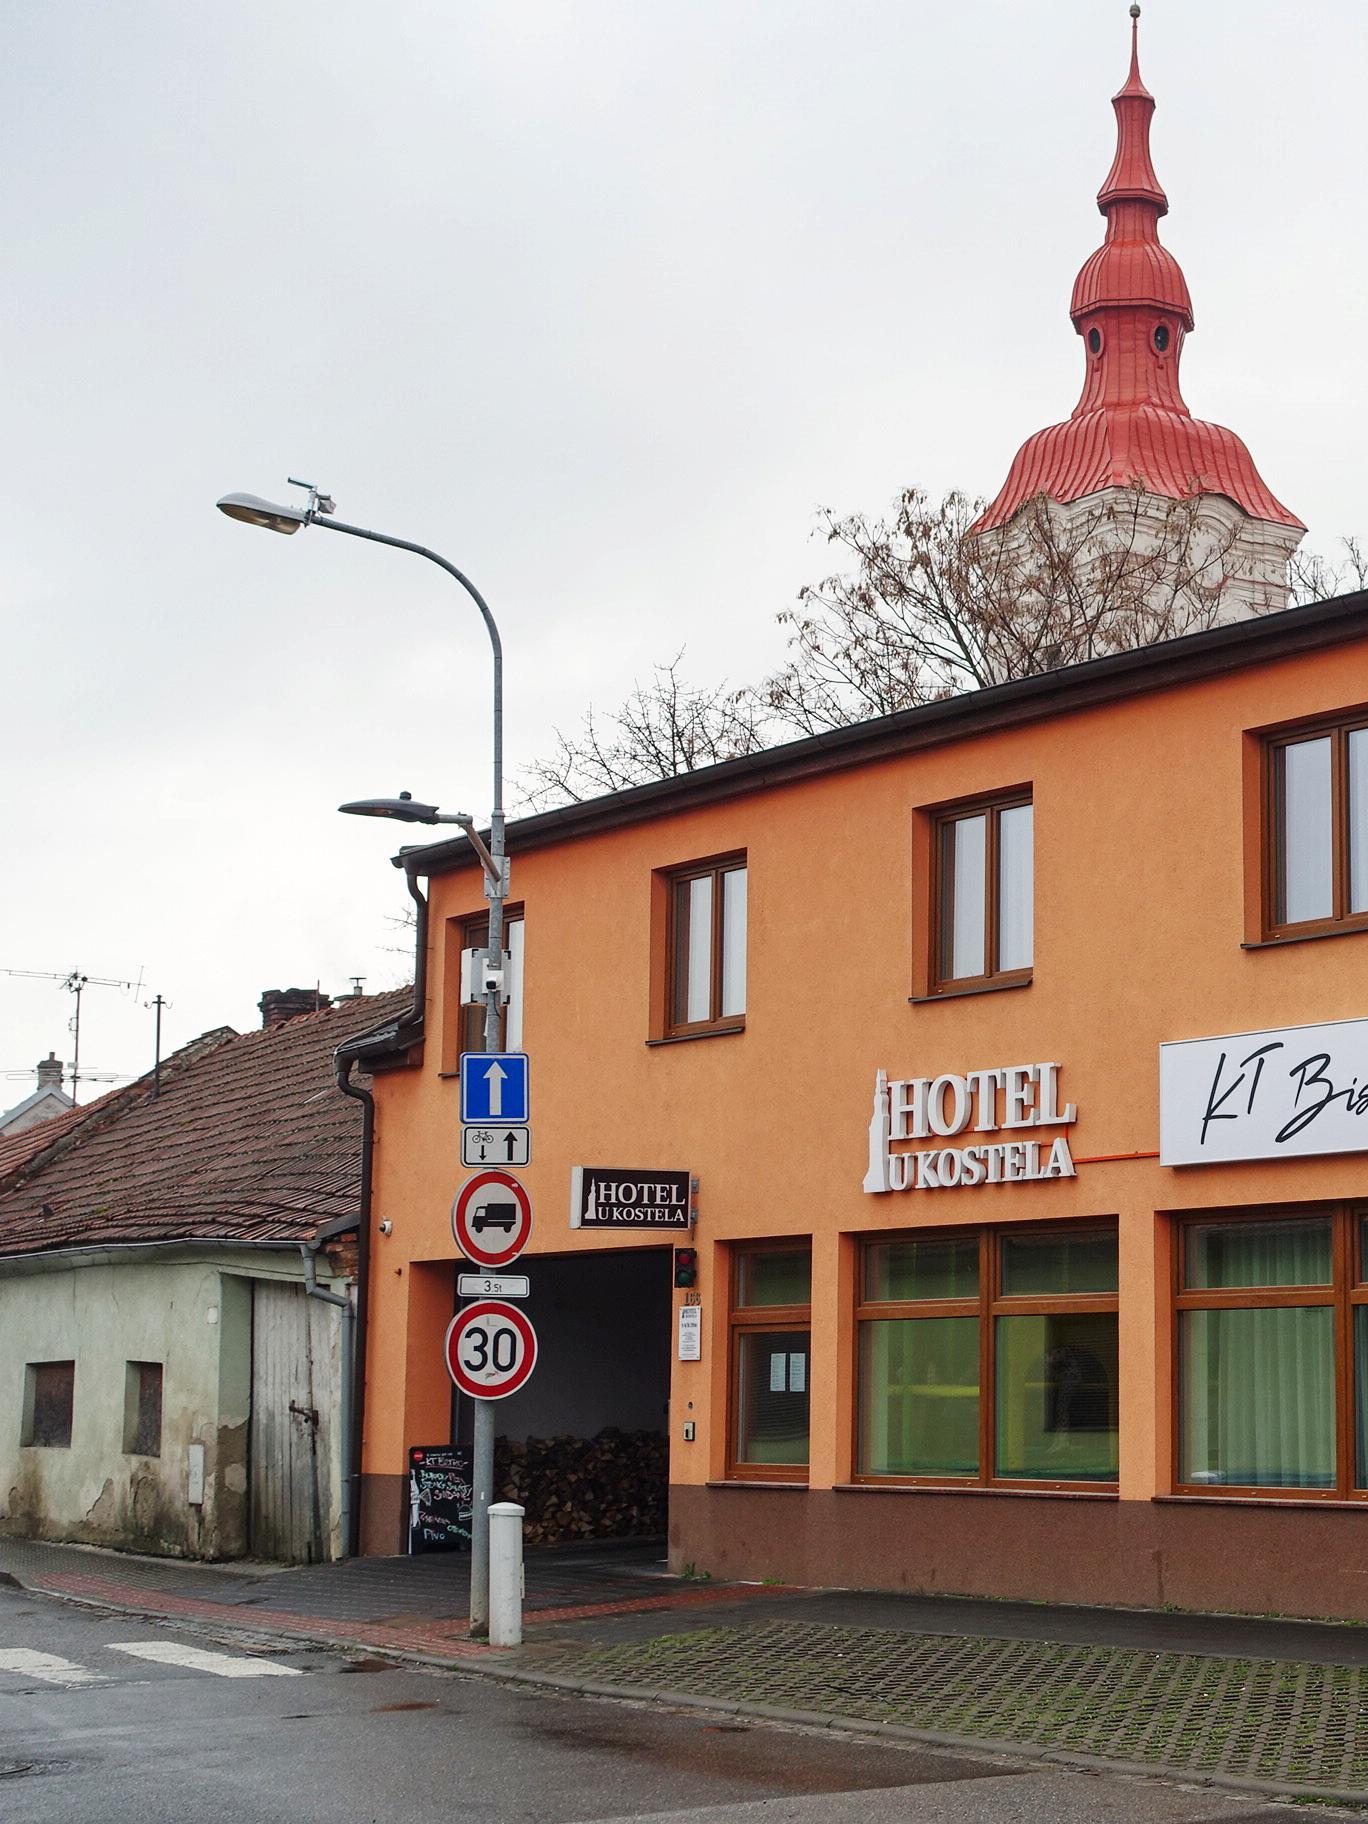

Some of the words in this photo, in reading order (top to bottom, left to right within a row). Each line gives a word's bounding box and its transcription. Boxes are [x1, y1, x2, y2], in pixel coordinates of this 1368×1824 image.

[887, 1061, 1077, 1140] HOTEL
[1200, 1042, 1284, 1145] KT
[888, 1153, 914, 1192] U
[915, 1137, 1077, 1189] KOSTELA
[597, 1181, 685, 1205] HOTEL
[598, 1206, 610, 1221] U
[612, 1207, 685, 1222] KOSTELA
[463, 1326, 517, 1372] 30
